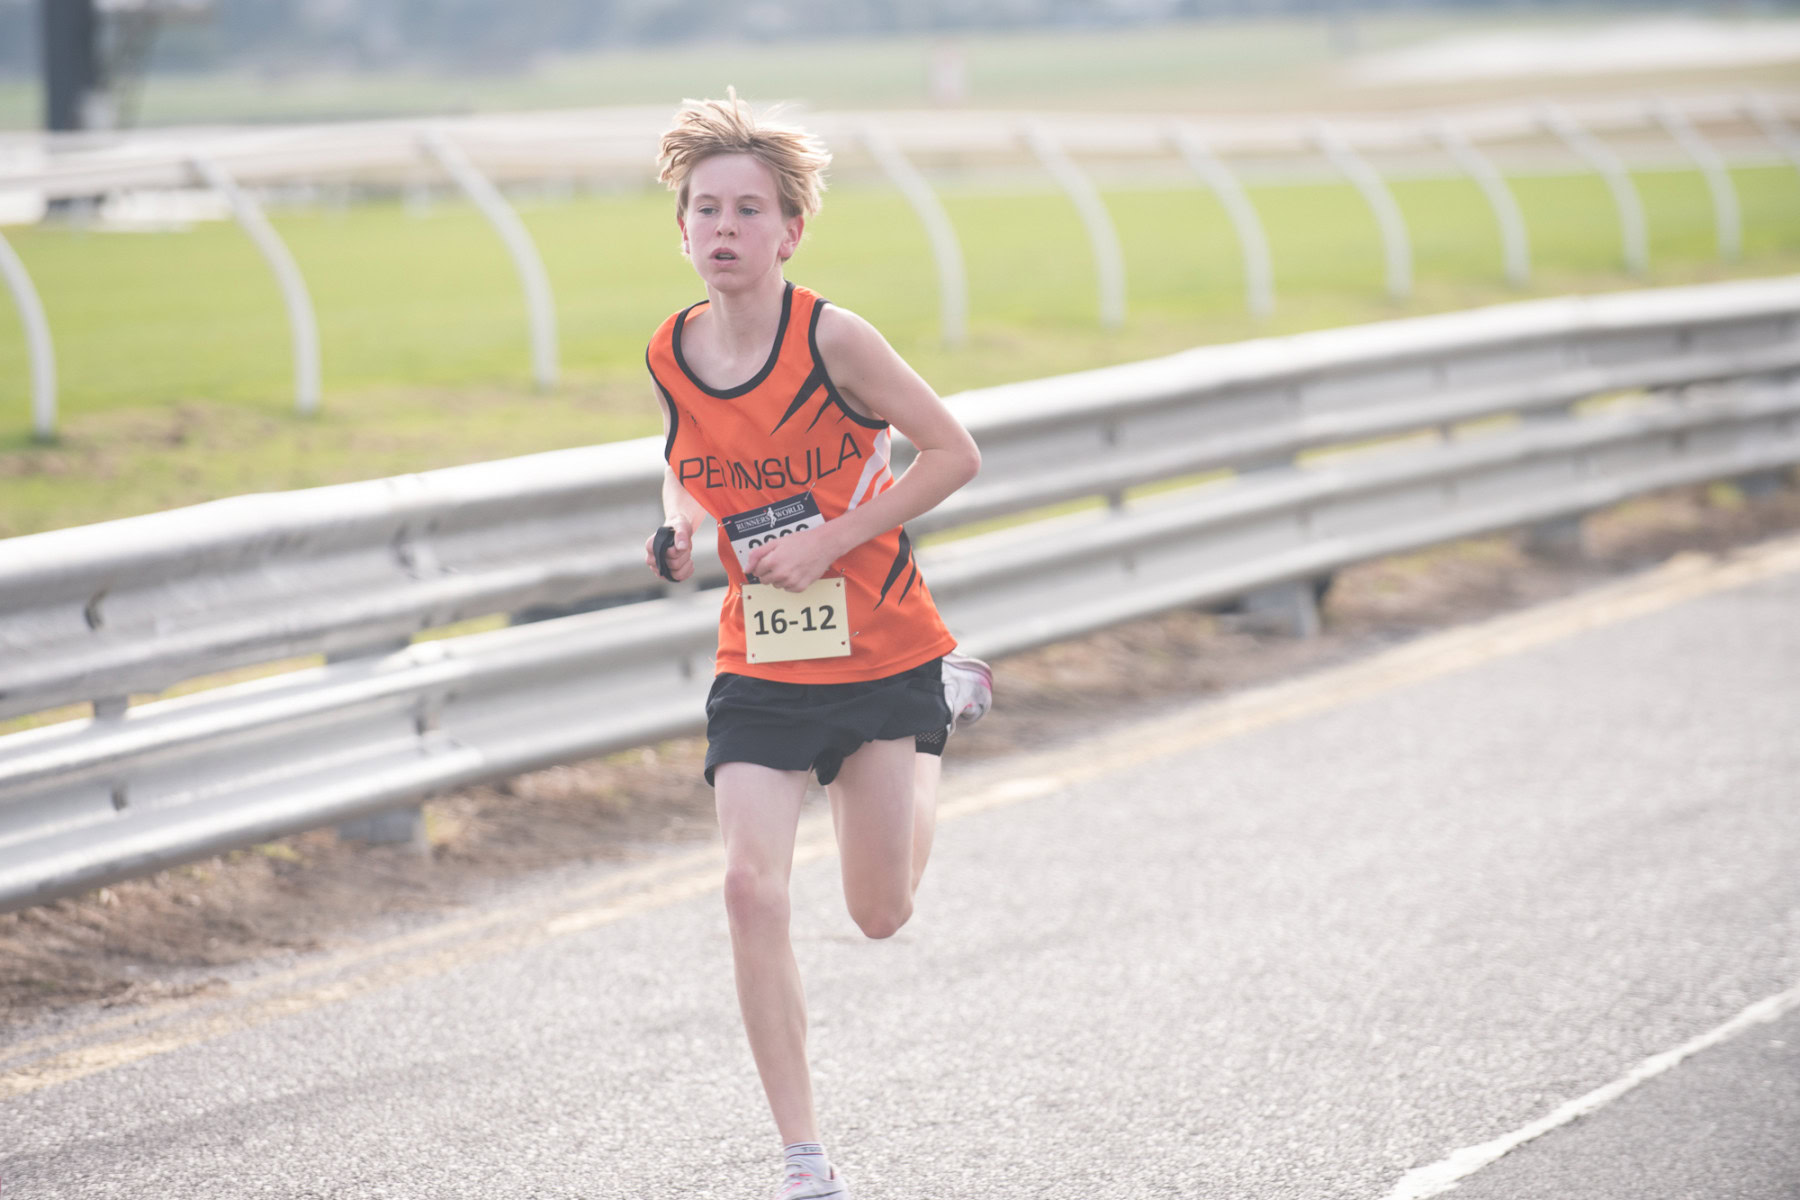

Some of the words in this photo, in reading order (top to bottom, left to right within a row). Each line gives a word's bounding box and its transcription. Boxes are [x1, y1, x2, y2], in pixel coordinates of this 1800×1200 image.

[736, 515, 770, 531] RUNNERS
[775, 503, 804, 518] WORLD
[753, 605, 837, 635] 16-12
